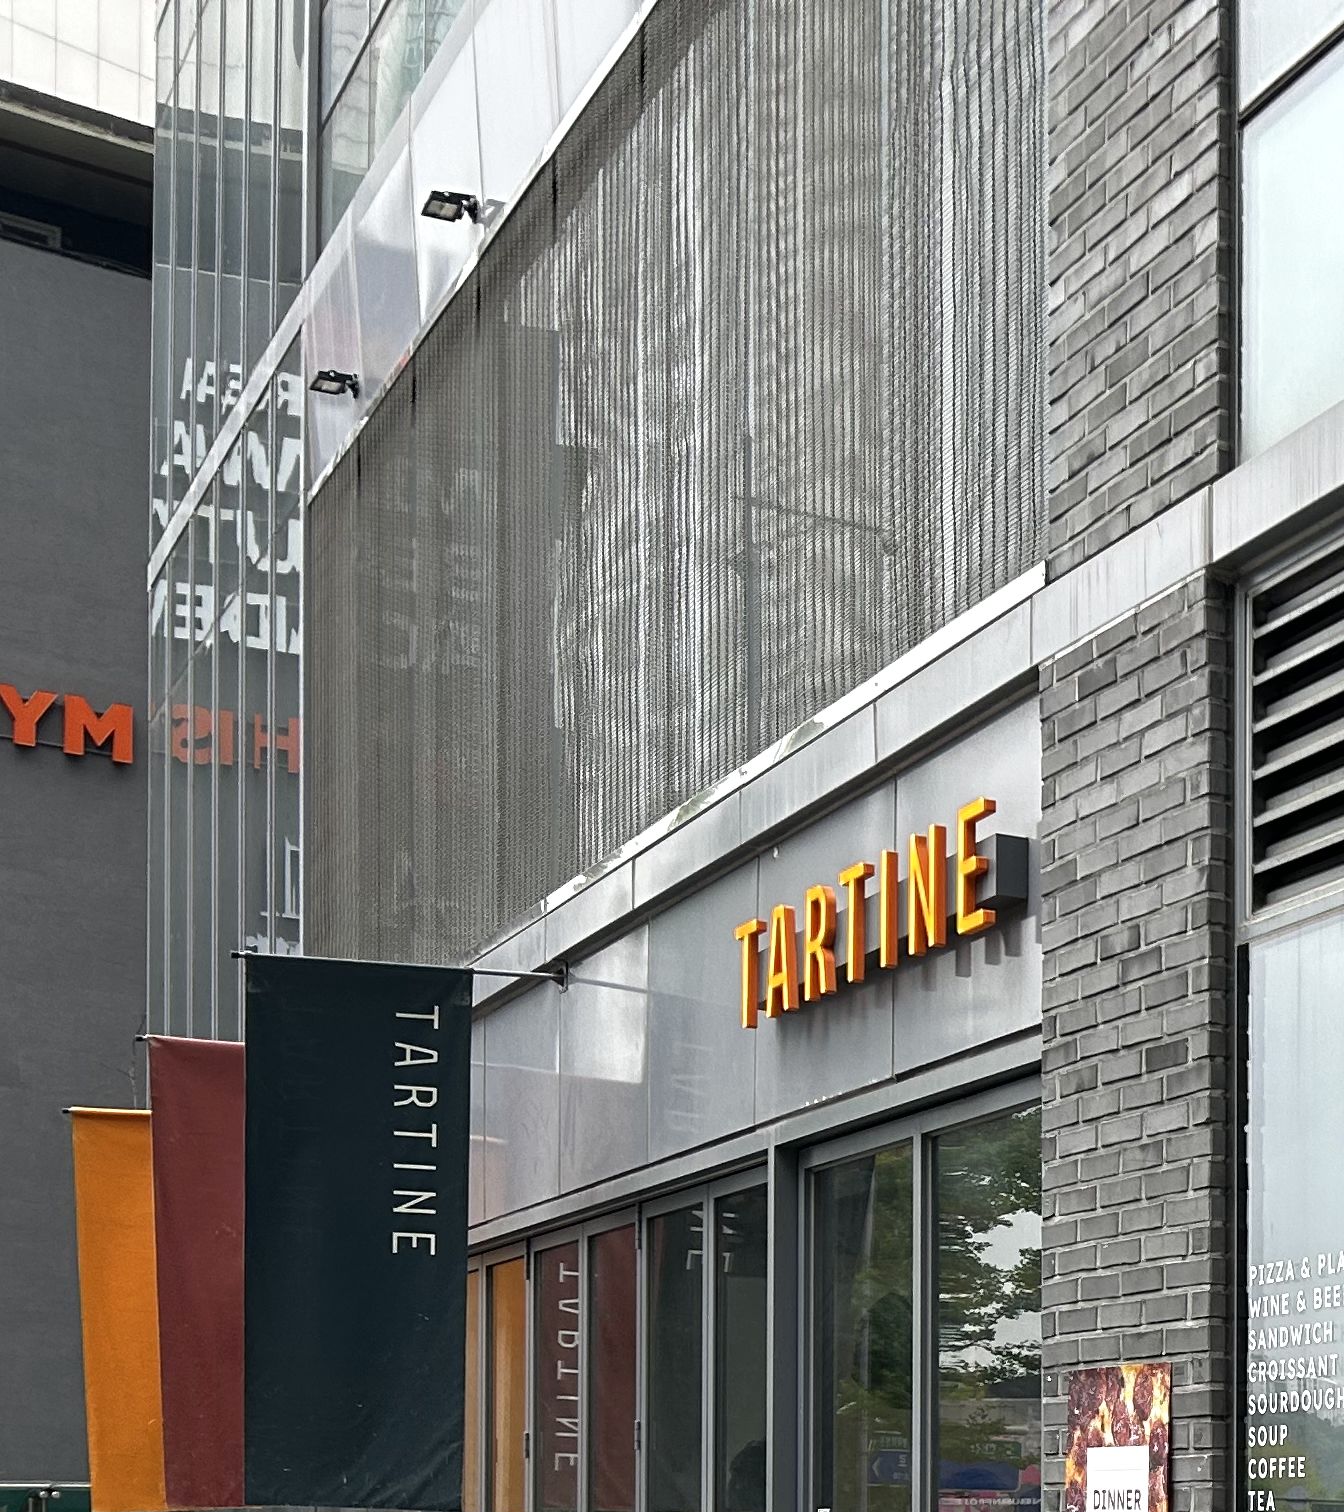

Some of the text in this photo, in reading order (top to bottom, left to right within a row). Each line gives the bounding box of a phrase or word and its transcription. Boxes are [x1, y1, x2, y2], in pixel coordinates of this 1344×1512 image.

[734, 797, 996, 1028] TARTINE
[392, 1005, 439, 1255] TARTINE
[1250, 1260, 1295, 1286] PIZZA
[1300, 1257, 1311, 1279] &
[1249, 1292, 1290, 1319] WINE
[1296, 1290, 1307, 1313] &
[1248, 1321, 1334, 1351] SANDWICH
[1248, 1353, 1338, 1383] CROISSANT
[1248, 1424, 1288, 1447] SOUP
[1248, 1456, 1306, 1479] COFFEE
[1093, 1489, 1142, 1511] DINNER
[1248, 1490, 1276, 1512] TEA
